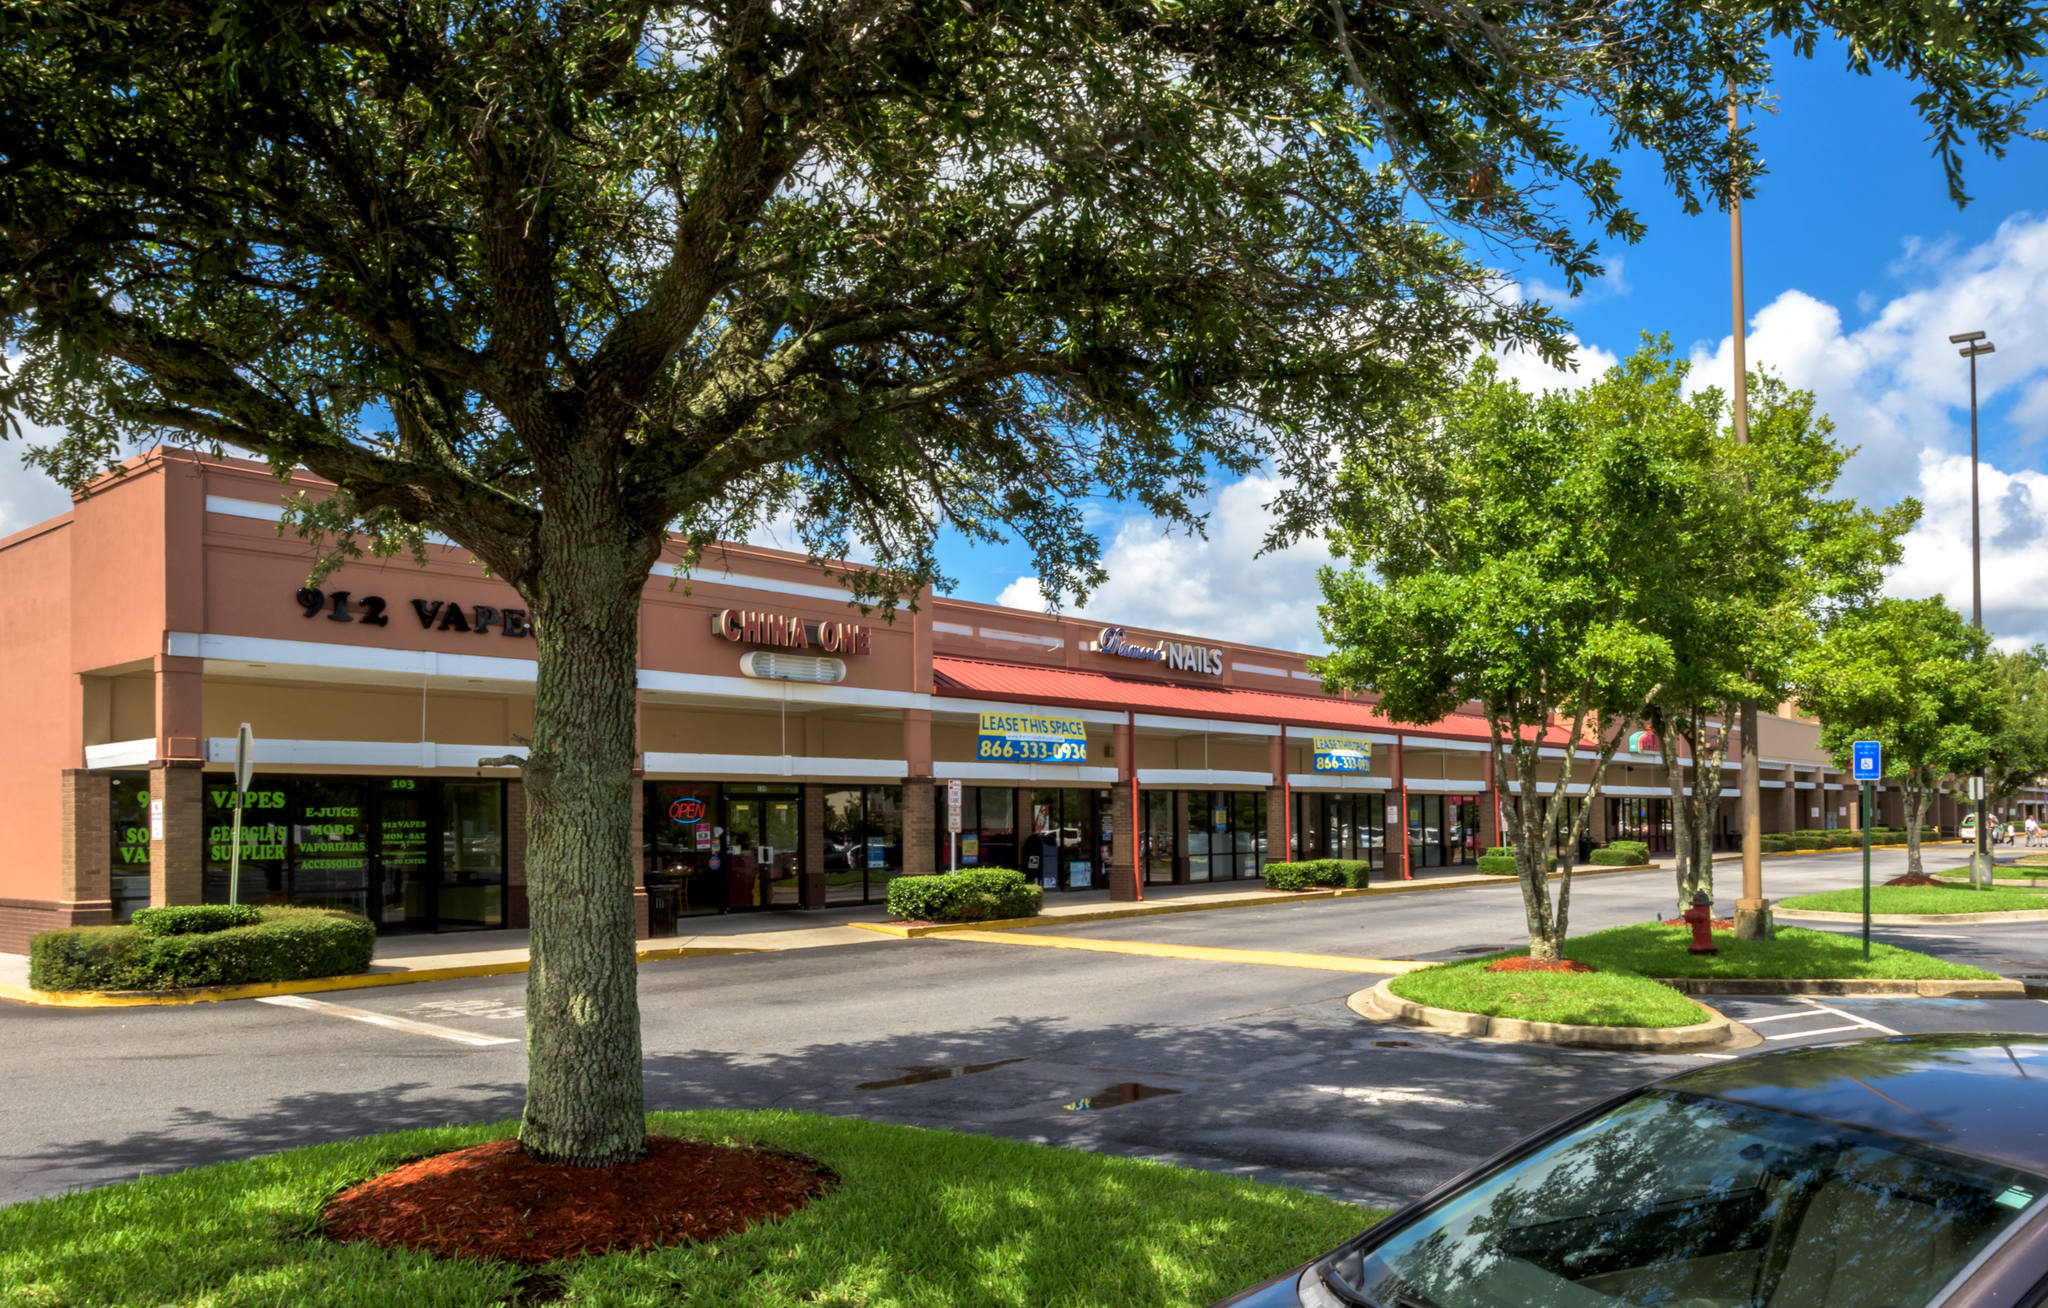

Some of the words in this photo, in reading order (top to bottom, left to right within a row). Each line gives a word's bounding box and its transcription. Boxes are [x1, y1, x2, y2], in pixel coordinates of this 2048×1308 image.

[296, 587, 389, 627] 912
[410, 598, 536, 639] VAPE
[720, 608, 809, 648] CHINA
[818, 620, 872, 656] ONE
[1097, 627, 1165, 660] Diamond
[1166, 641, 1223, 675] NAILS
[981, 715, 1019, 732] LEASE
[1020, 718, 1049, 734] THIS
[1049, 720, 1084, 736] SPACE
[980, 740, 1087, 760] 866-333-0936
[392, 779, 416, 790] 103
[211, 791, 286, 808] VAPES
[305, 807, 359, 817] E-JUICE
[669, 803, 706, 819] OPEN
[310, 824, 354, 835] MODS
[120, 847, 151, 864] VA
[210, 844, 286, 861] SUPLIER
[299, 842, 365, 853] VAPORIZERS
[301, 859, 363, 870] ACCESSORIES
